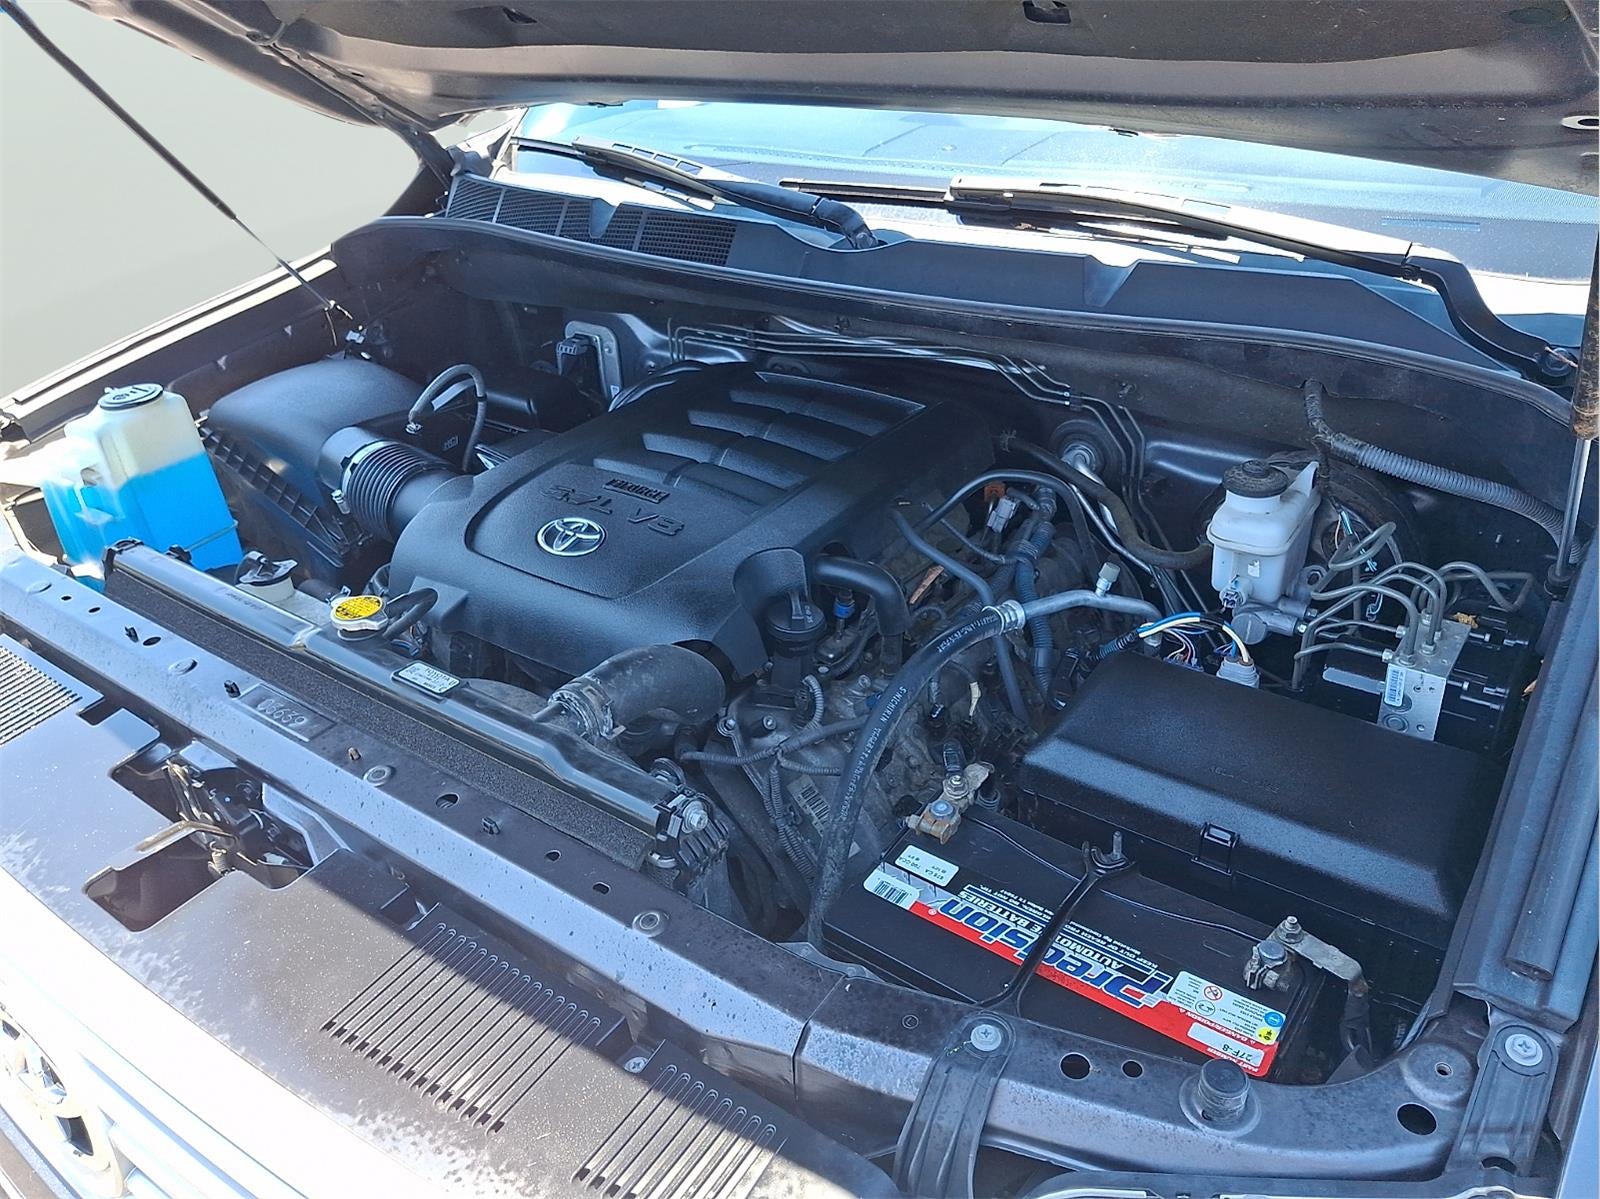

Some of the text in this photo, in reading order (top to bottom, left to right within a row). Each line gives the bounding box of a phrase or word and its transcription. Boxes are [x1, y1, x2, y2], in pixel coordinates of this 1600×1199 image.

[628, 507, 685, 537] V8
[992, 890, 1008, 901] NOT
[957, 889, 1123, 970] AUTOMOTE BATTERIES
[1063, 923, 1080, 933] FRO
[1079, 930, 1106, 945] REACH
[937, 895, 1173, 1008] Precision
[1105, 942, 1119, 951] OF
[1118, 948, 1136, 958] OUT
[1135, 956, 1158, 968] KEEP
[1221, 1042, 1253, 1062] 27F-8
[1237, 1060, 1259, 1072] PART
